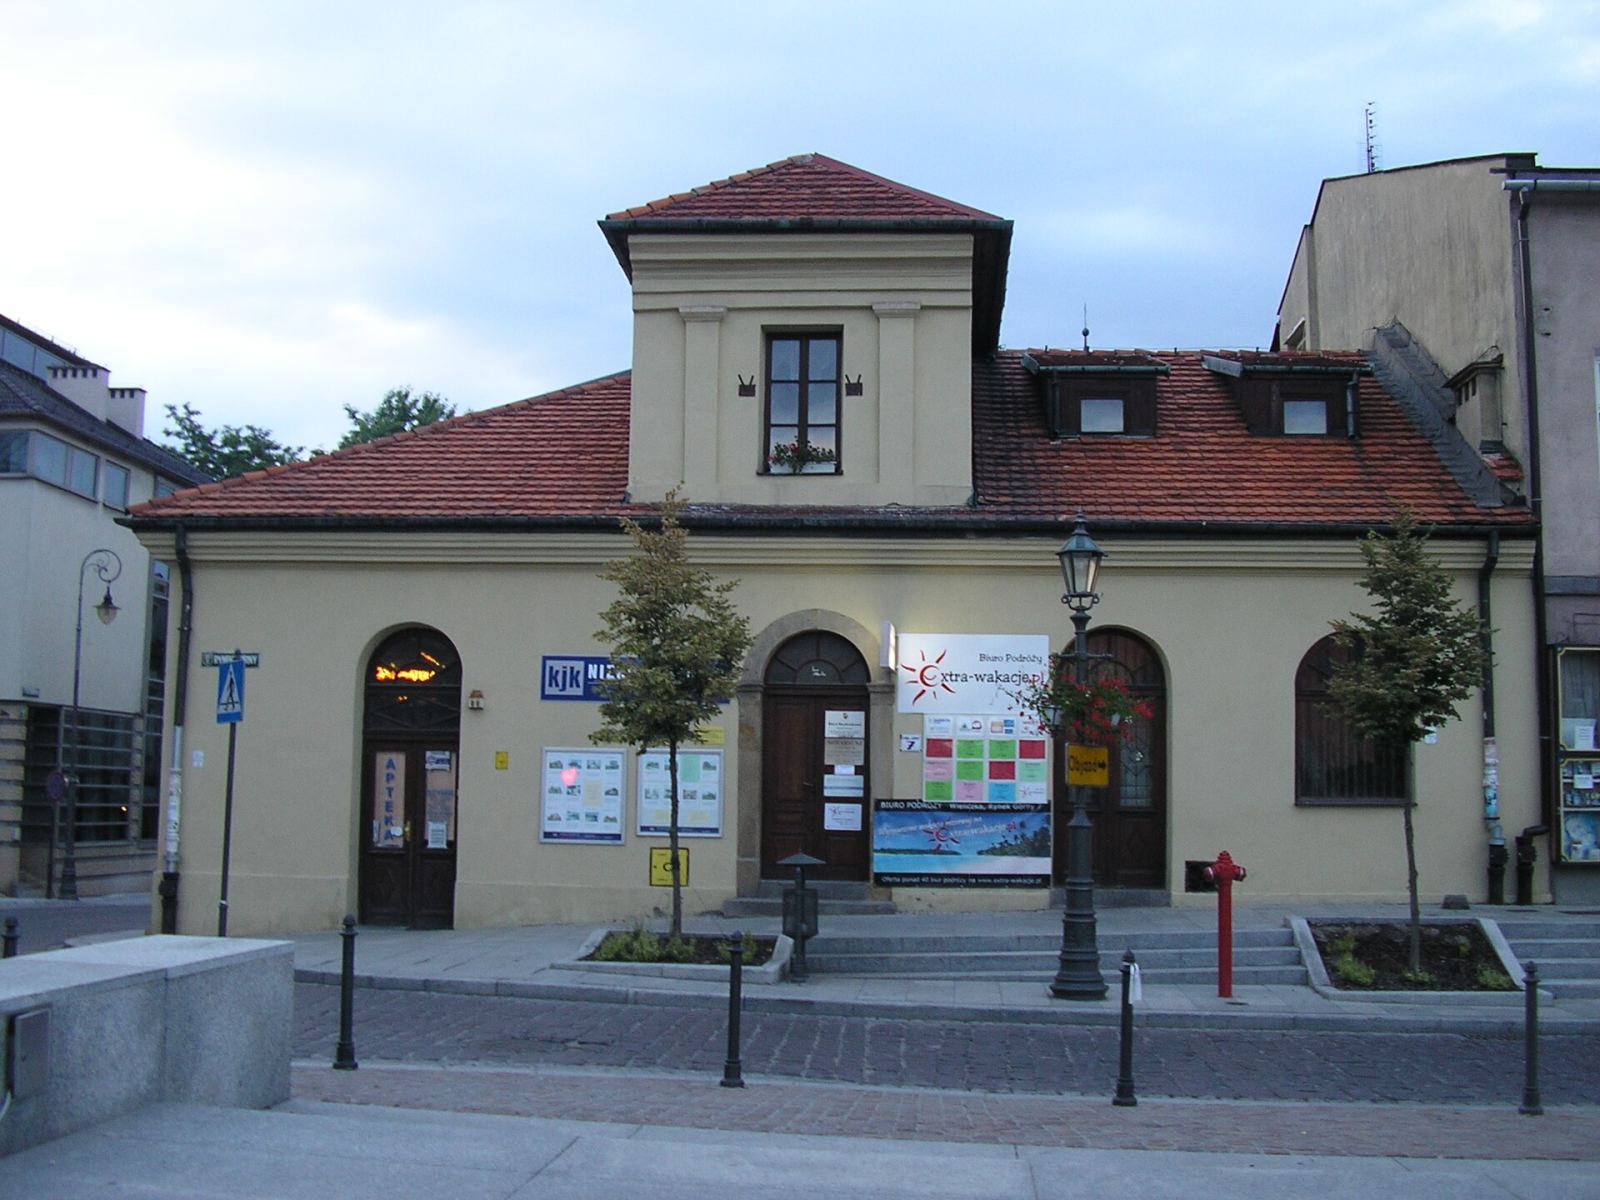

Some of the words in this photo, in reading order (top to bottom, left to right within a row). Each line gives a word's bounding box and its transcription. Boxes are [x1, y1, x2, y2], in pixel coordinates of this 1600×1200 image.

[979, 653, 1003, 663] Biuro
[1005, 653, 1043, 665] Podróży
[548, 665, 581, 692] kjk
[907, 740, 916, 750] 7
[384, 757, 396, 841] APTEKA
[880, 801, 905, 809] BIURO
